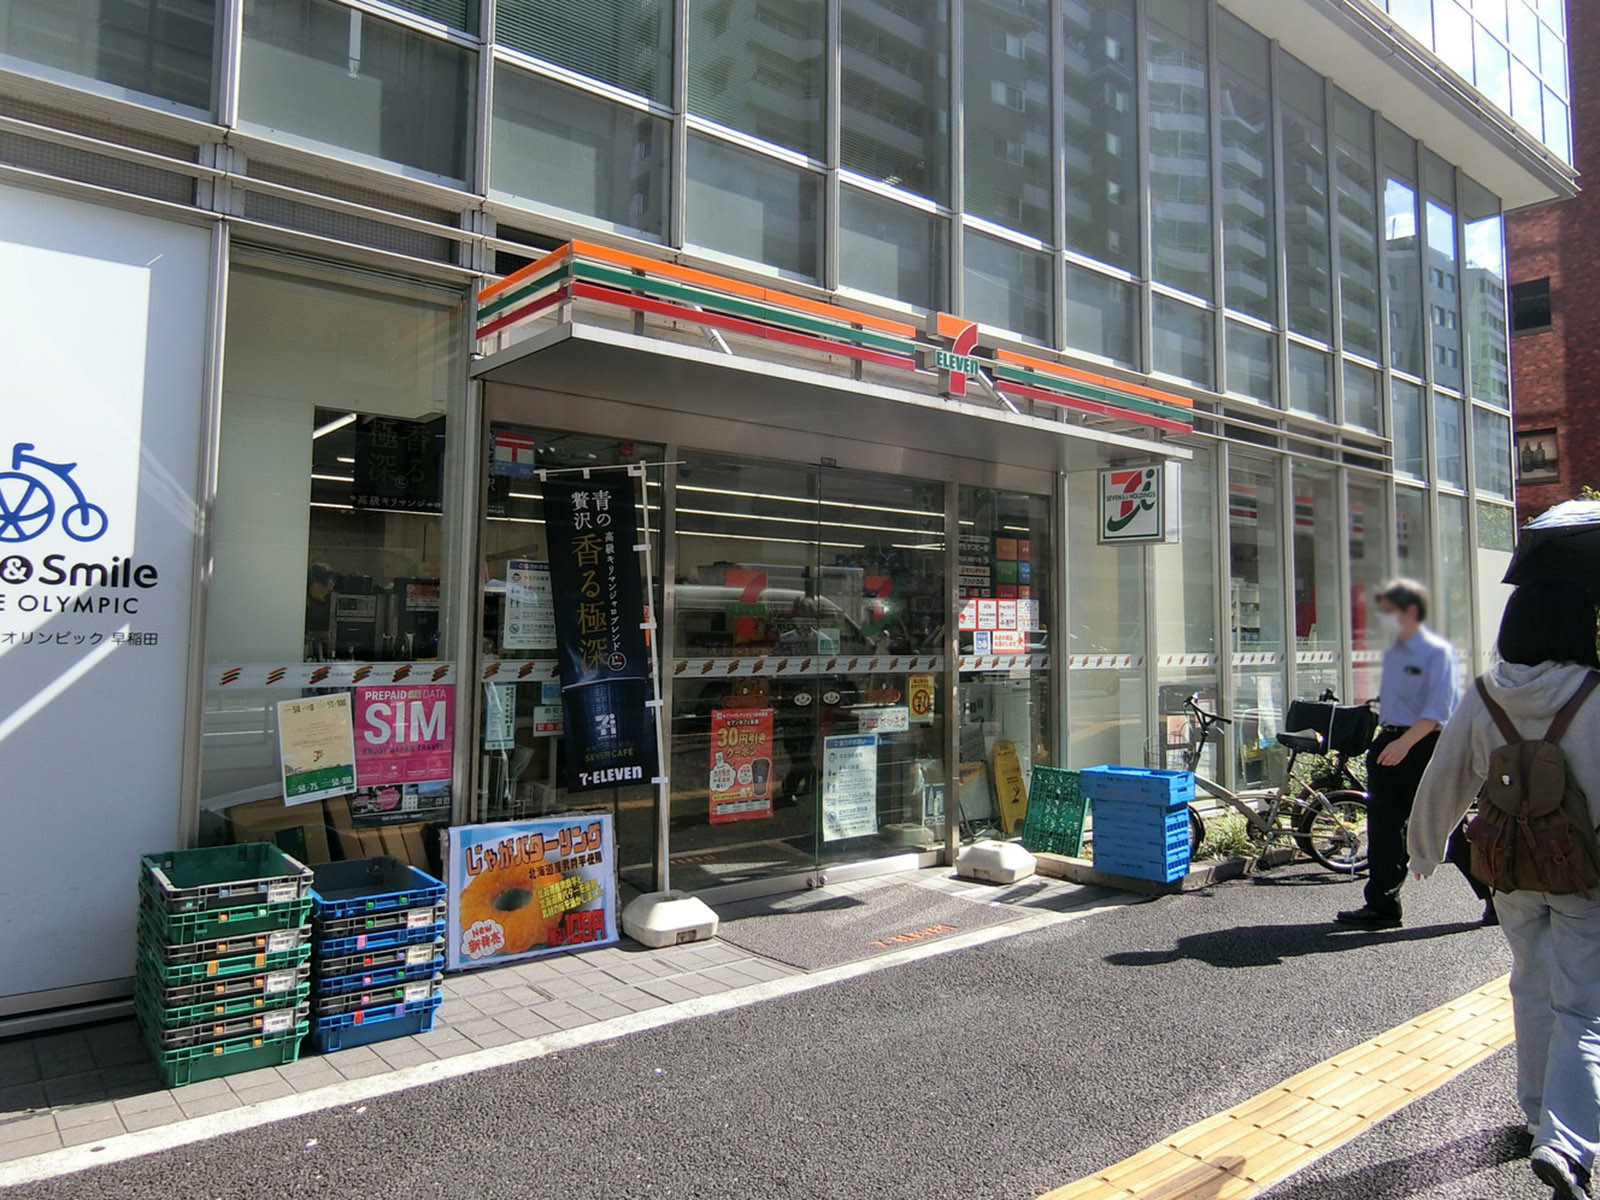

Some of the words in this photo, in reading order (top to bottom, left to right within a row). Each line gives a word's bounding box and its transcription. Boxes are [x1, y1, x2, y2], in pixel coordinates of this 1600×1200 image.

[571, 490, 593, 531] 贅沢
[591, 489, 612, 528] 青の
[18, 595, 138, 614] OLYMPIC
[571, 532, 610, 672] 香る極深
[112, 632, 158, 646] 早稲田
[365, 690, 407, 701] PREPAID
[422, 689, 447, 699] DATA
[363, 700, 447, 745] SIM
[417, 743, 444, 752] TRAVEL
[465, 821, 603, 877] じゃがバターリング
[467, 932, 502, 953] 新発売
